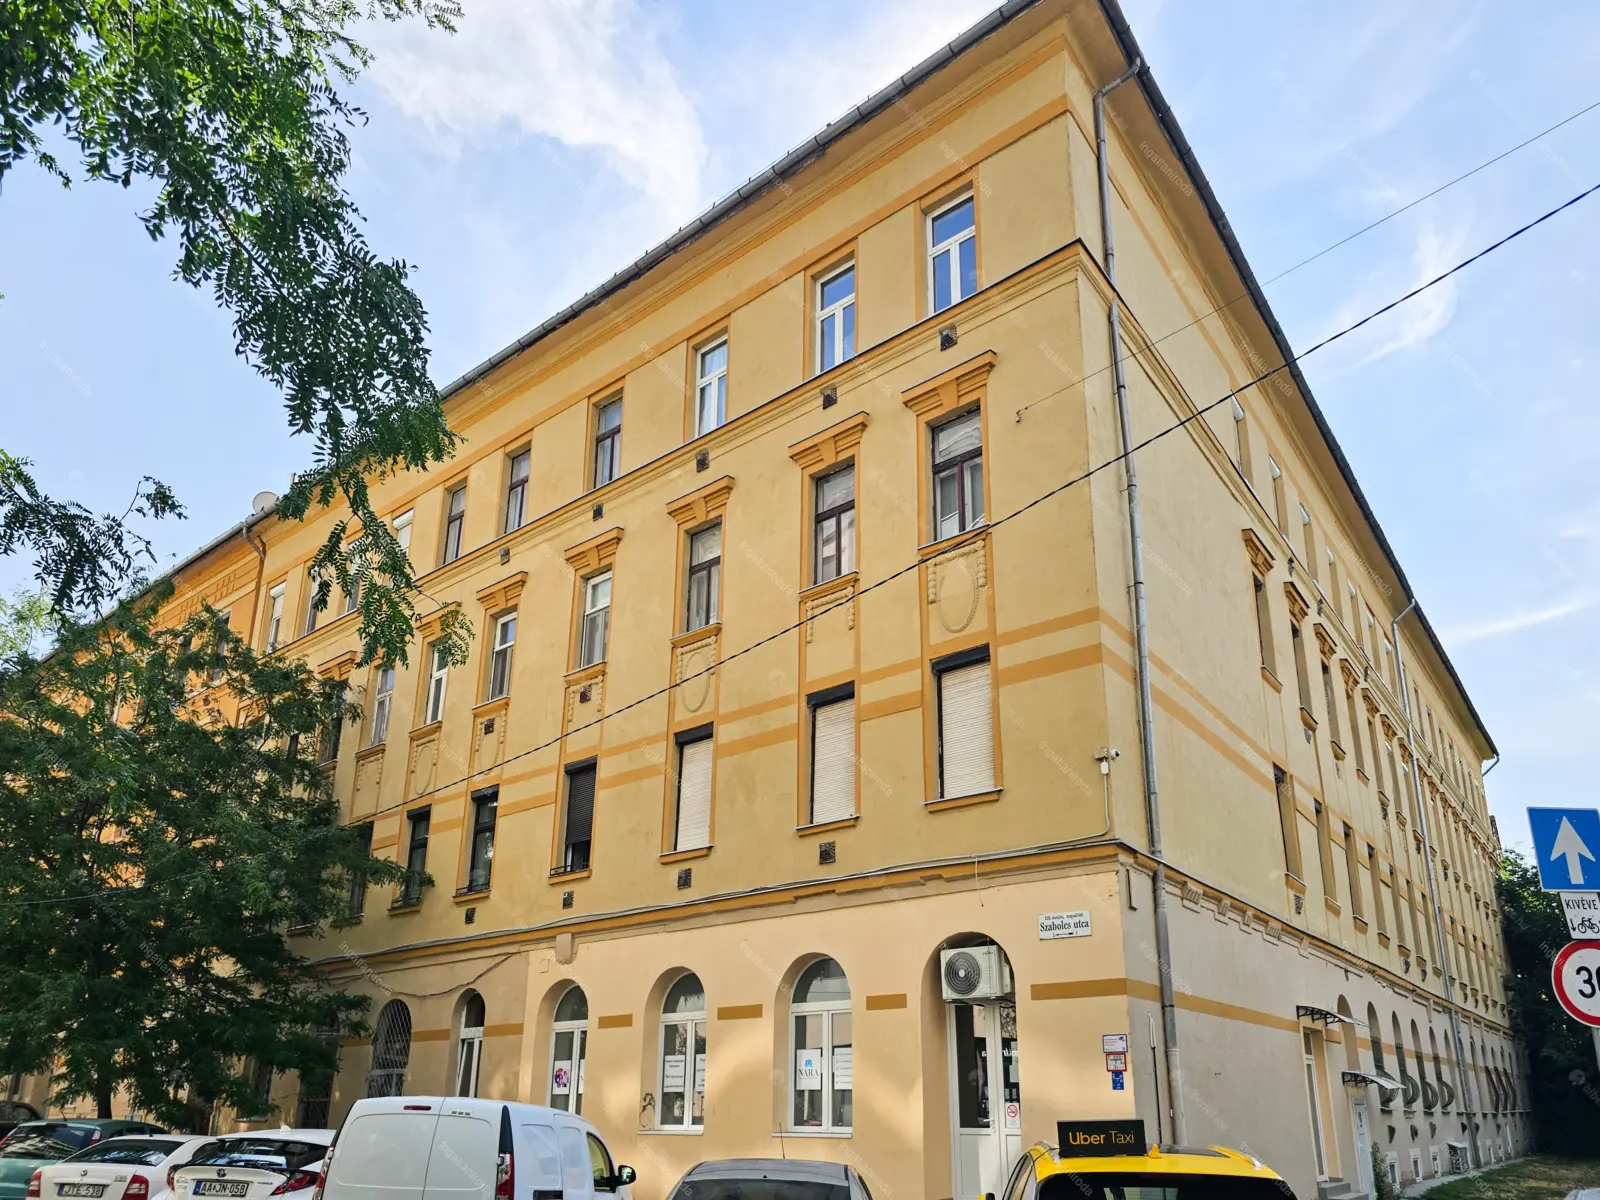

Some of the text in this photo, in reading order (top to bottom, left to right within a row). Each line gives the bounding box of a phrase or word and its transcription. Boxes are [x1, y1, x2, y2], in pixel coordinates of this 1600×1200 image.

[1564, 897, 1599, 910] KIVÉVE
[1040, 919, 1089, 932] Szabolcs utca
[1575, 965, 1600, 999] 3
[798, 1068, 819, 1077] NARA
[1068, 1130, 1135, 1145] Uber Taxi
[64, 1185, 101, 1196] JTE-538
